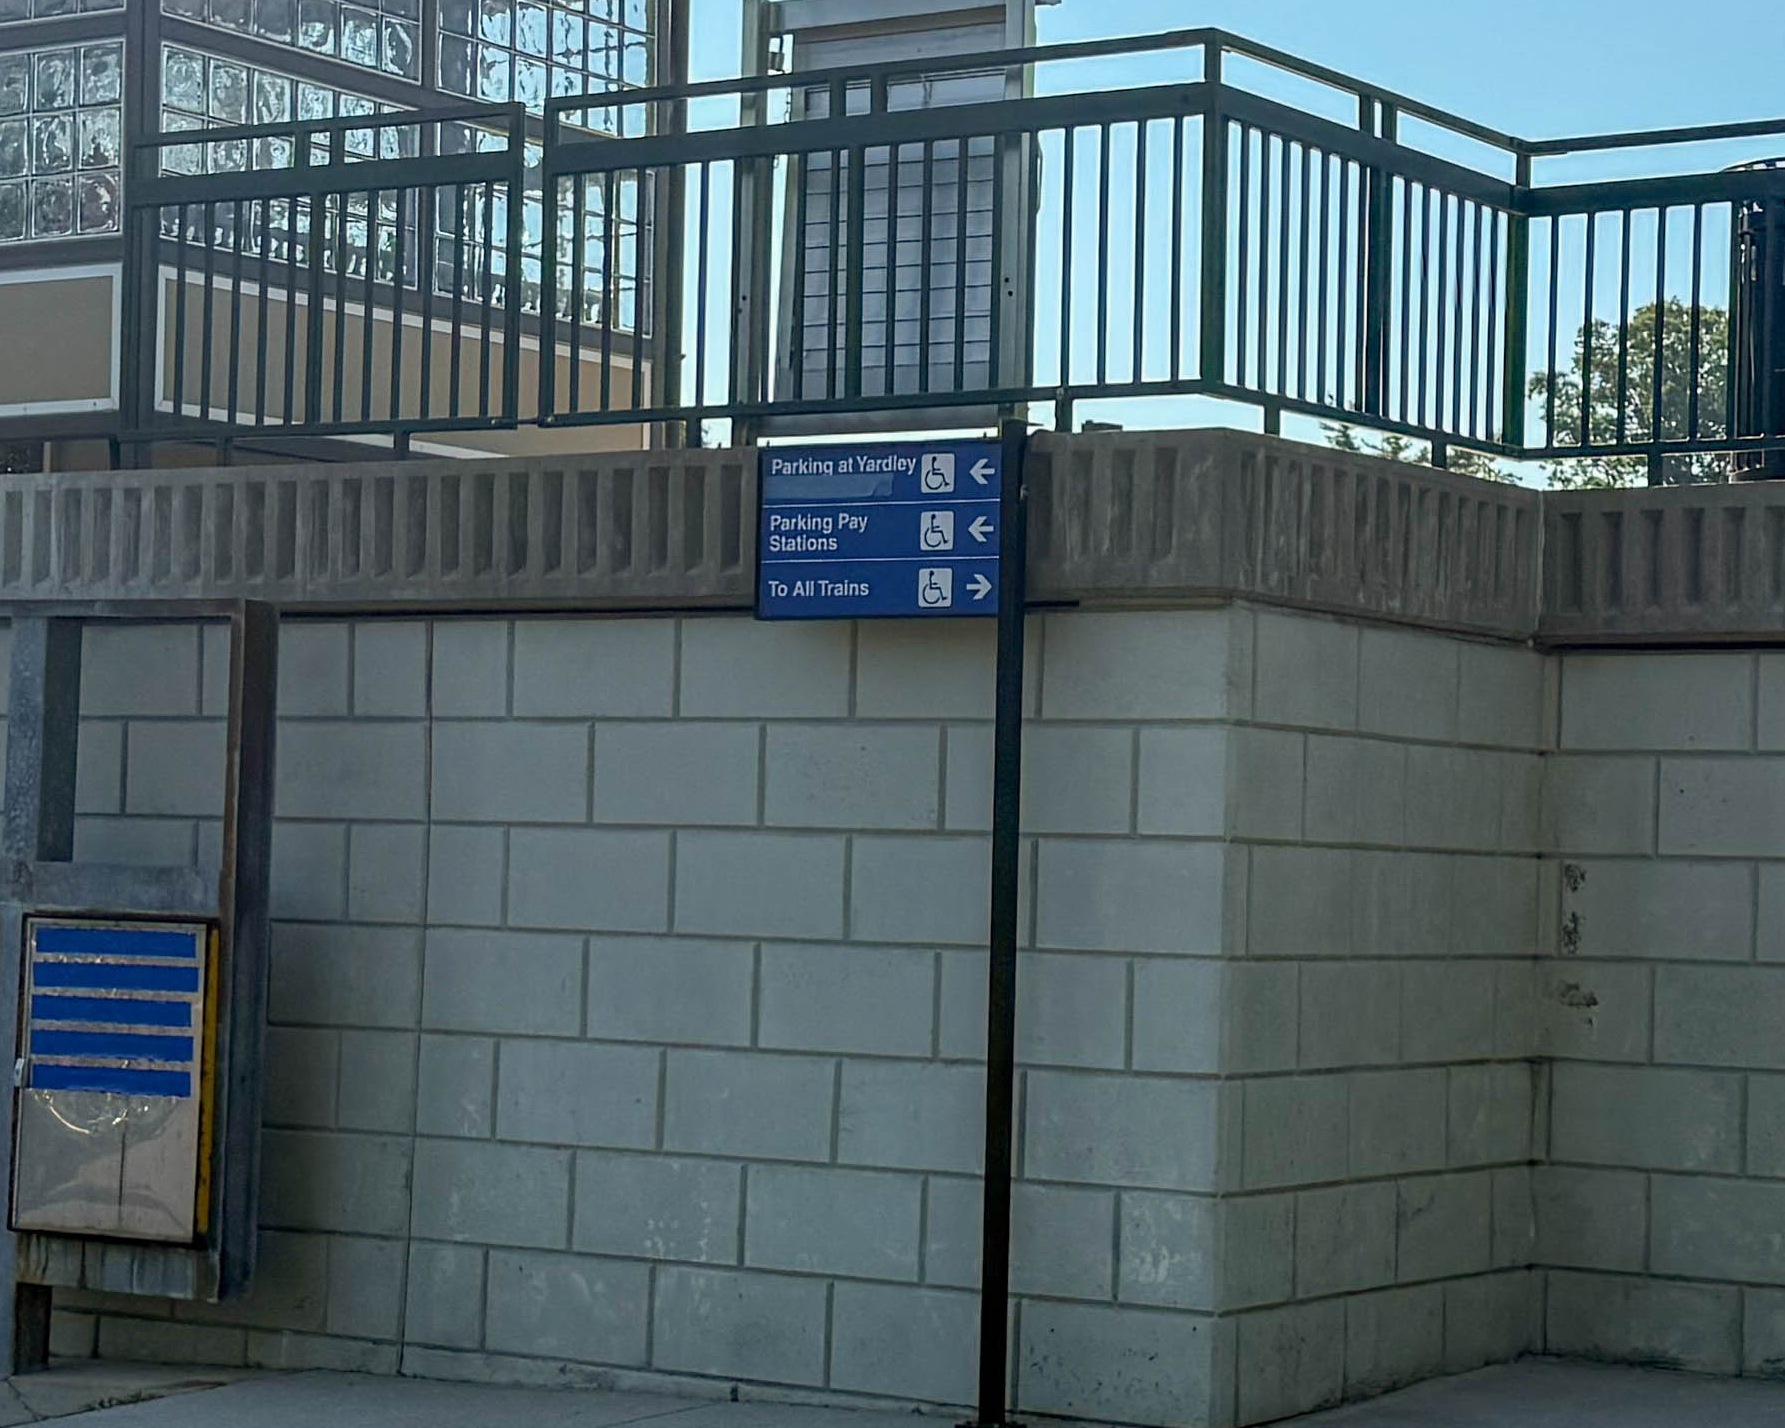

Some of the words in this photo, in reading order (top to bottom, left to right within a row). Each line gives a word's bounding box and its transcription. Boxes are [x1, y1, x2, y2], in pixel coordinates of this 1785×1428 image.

[771, 458, 833, 475] Parking
[838, 457, 853, 472] at
[856, 455, 916, 475] Yardley
[770, 514, 833, 534] Parking
[838, 512, 868, 533] Pay
[769, 535, 838, 552] Stations
[768, 581, 787, 597] To
[793, 581, 814, 597] All
[818, 579, 869, 597] Trains
